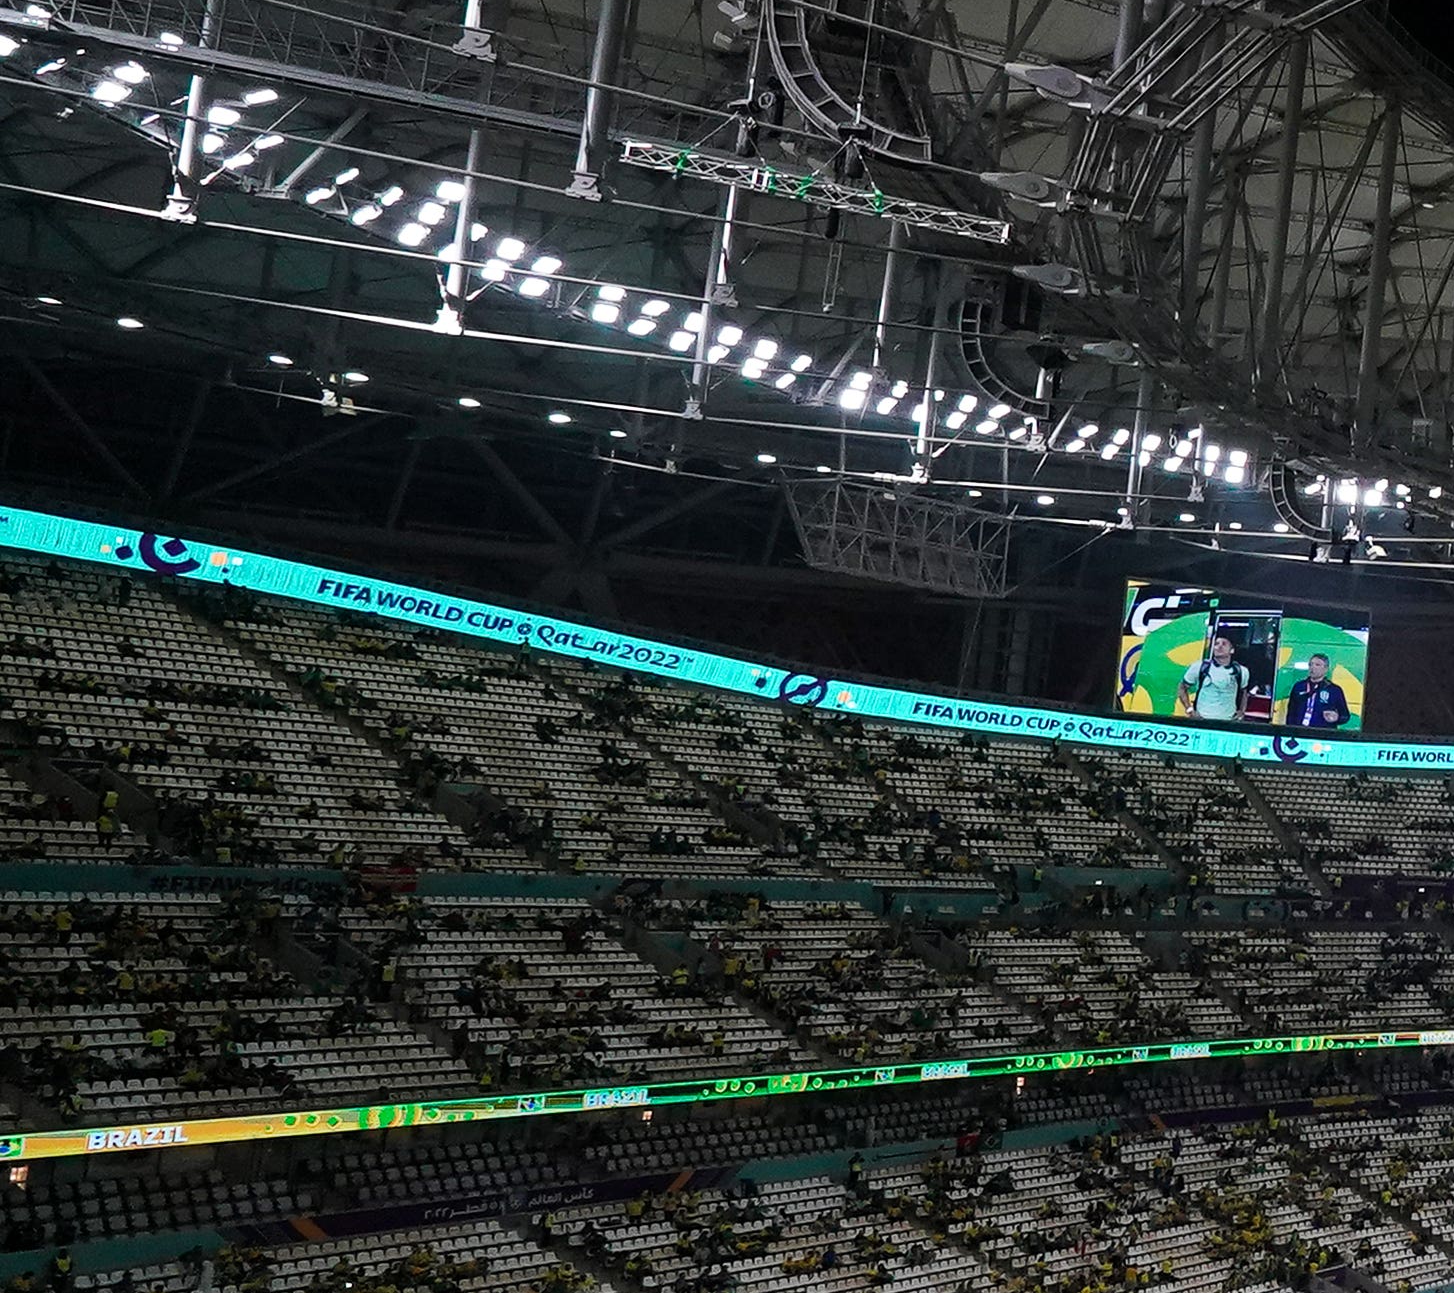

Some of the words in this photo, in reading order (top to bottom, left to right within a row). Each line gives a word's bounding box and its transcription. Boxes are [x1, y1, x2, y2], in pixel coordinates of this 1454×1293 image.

[317, 578, 373, 603] FIFA
[376, 589, 464, 622] WORLD
[466, 612, 513, 632] CUP
[912, 701, 953, 718] FIFA
[957, 708, 1023, 727] WORLD
[1026, 716, 1059, 731] CUP
[1377, 749, 1409, 762] FIFA
[87, 1126, 189, 1150] BRAZIL
